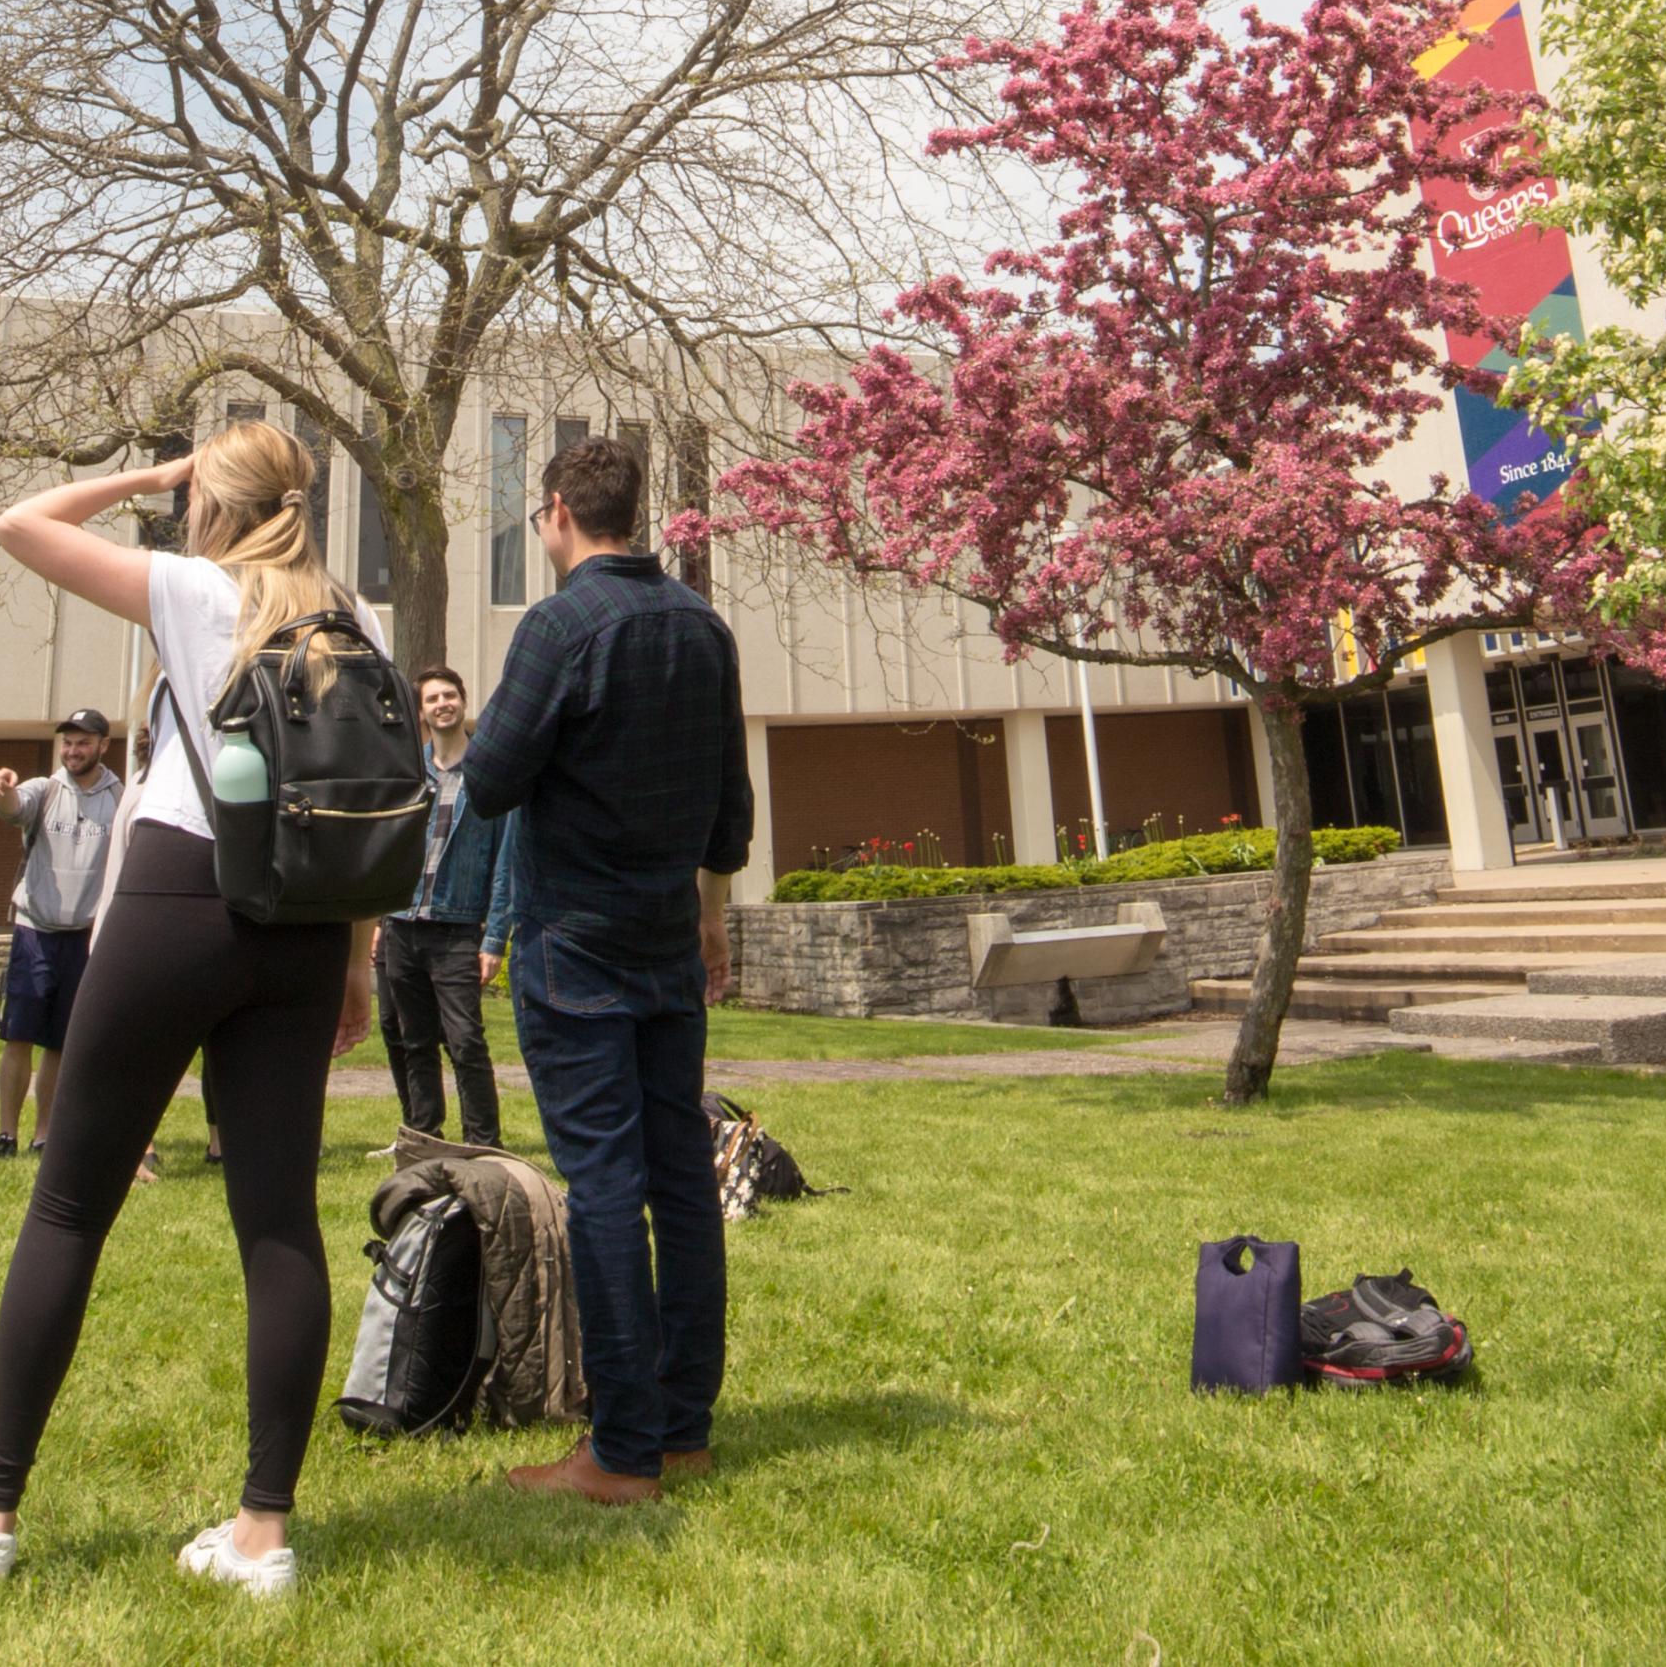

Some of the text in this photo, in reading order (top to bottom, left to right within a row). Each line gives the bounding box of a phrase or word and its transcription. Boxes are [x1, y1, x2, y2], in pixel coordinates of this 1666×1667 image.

[1436, 181, 1549, 258] Queen's
[1499, 451, 1572, 485] Since 1841
